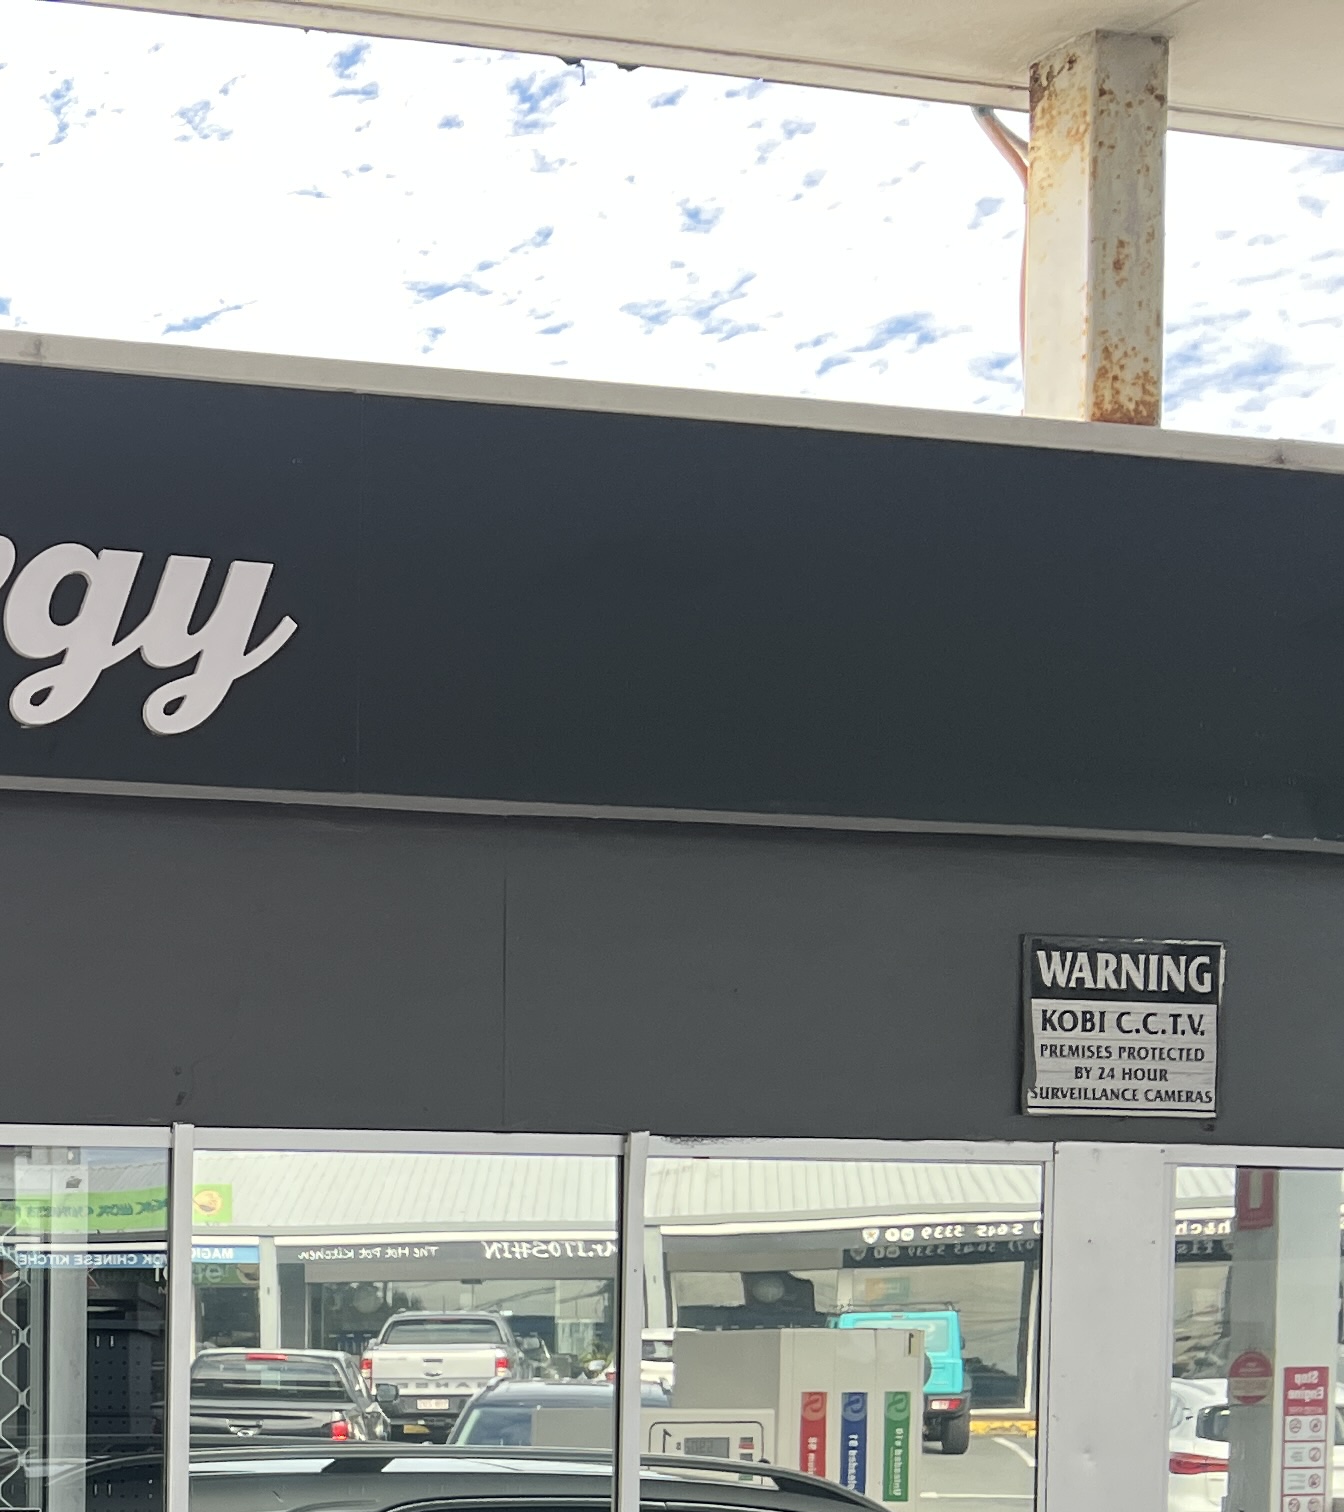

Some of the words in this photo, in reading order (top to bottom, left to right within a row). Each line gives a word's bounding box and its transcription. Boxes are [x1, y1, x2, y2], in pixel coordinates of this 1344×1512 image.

[1036, 950, 1213, 994] WARNING
[1041, 1008, 1107, 1034] KOBI
[1115, 1011, 1206, 1037] C.C.T.V.
[1040, 1043, 1112, 1060] PREMISES
[1118, 1046, 1205, 1062] PROTECTED
[1073, 1065, 1093, 1080] BY
[1097, 1066, 1116, 1081] 24
[1121, 1067, 1169, 1082] HOUR
[1030, 1086, 1140, 1102] SURVEILLANCE
[1143, 1088, 1213, 1104] CAMERAS
